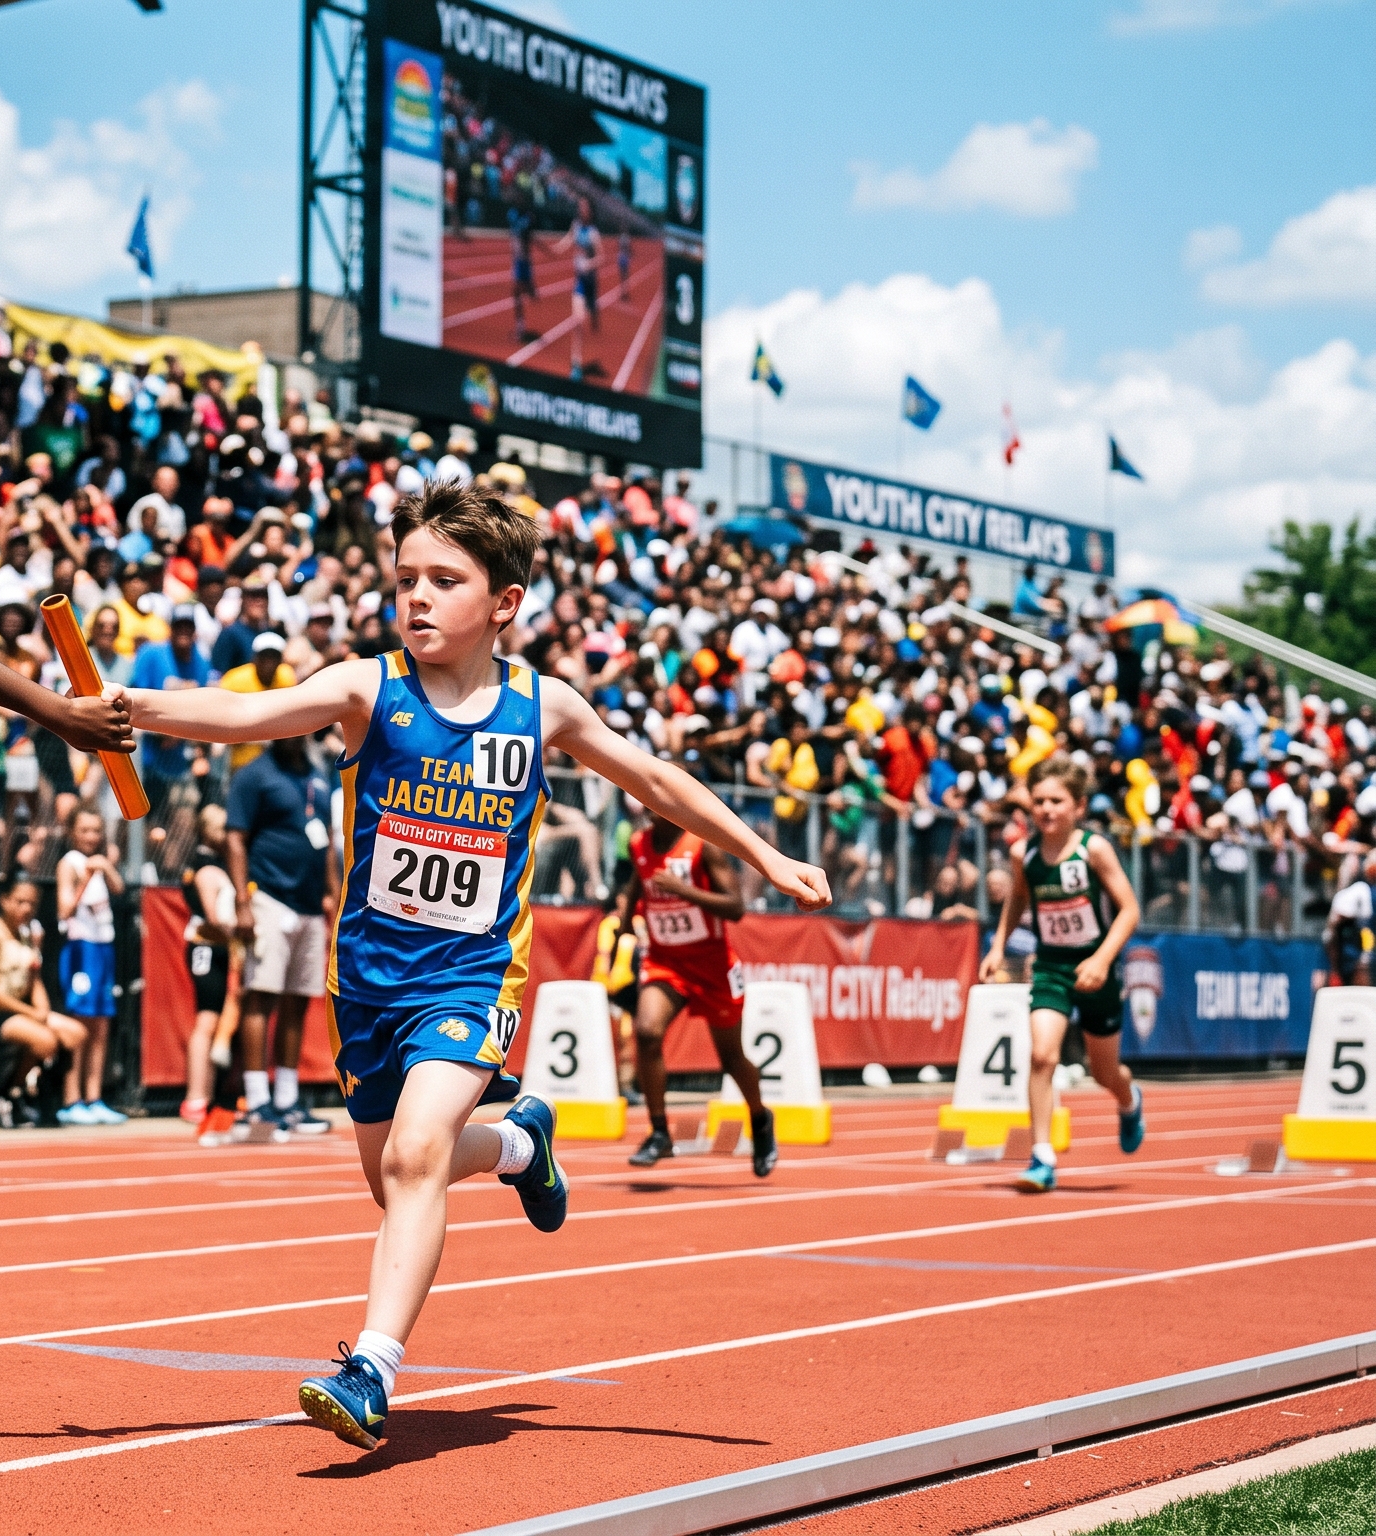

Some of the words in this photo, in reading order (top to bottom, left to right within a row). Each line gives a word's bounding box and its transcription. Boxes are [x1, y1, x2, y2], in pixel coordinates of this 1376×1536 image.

[437, 1, 523, 73] YOUTH
[526, 34, 581, 92] CITY
[582, 53, 669, 124] RELAYS
[676, 273, 695, 325] 3
[501, 384, 552, 423] YOUTH
[552, 395, 583, 429] CITY
[583, 403, 642, 443] RELAYS
[825, 472, 922, 534] YOUTH
[925, 495, 984, 546] CITY
[985, 508, 1071, 565] RELAYS
[480, 737, 528, 788] 10
[378, 777, 515, 828] JAGUARS
[388, 820, 425, 840] YOUTH
[425, 827, 453, 844] CITY
[453, 834, 495, 851] RELAYS
[388, 847, 481, 908] 209
[1067, 865, 1081, 889] 3
[831, 965, 885, 1021] CITY
[886, 965, 962, 1033] Relays
[550, 1030, 578, 1078] 3
[754, 1032, 783, 1080] 2
[982, 1036, 1017, 1087] 4
[1331, 1042, 1366, 1095] 5
